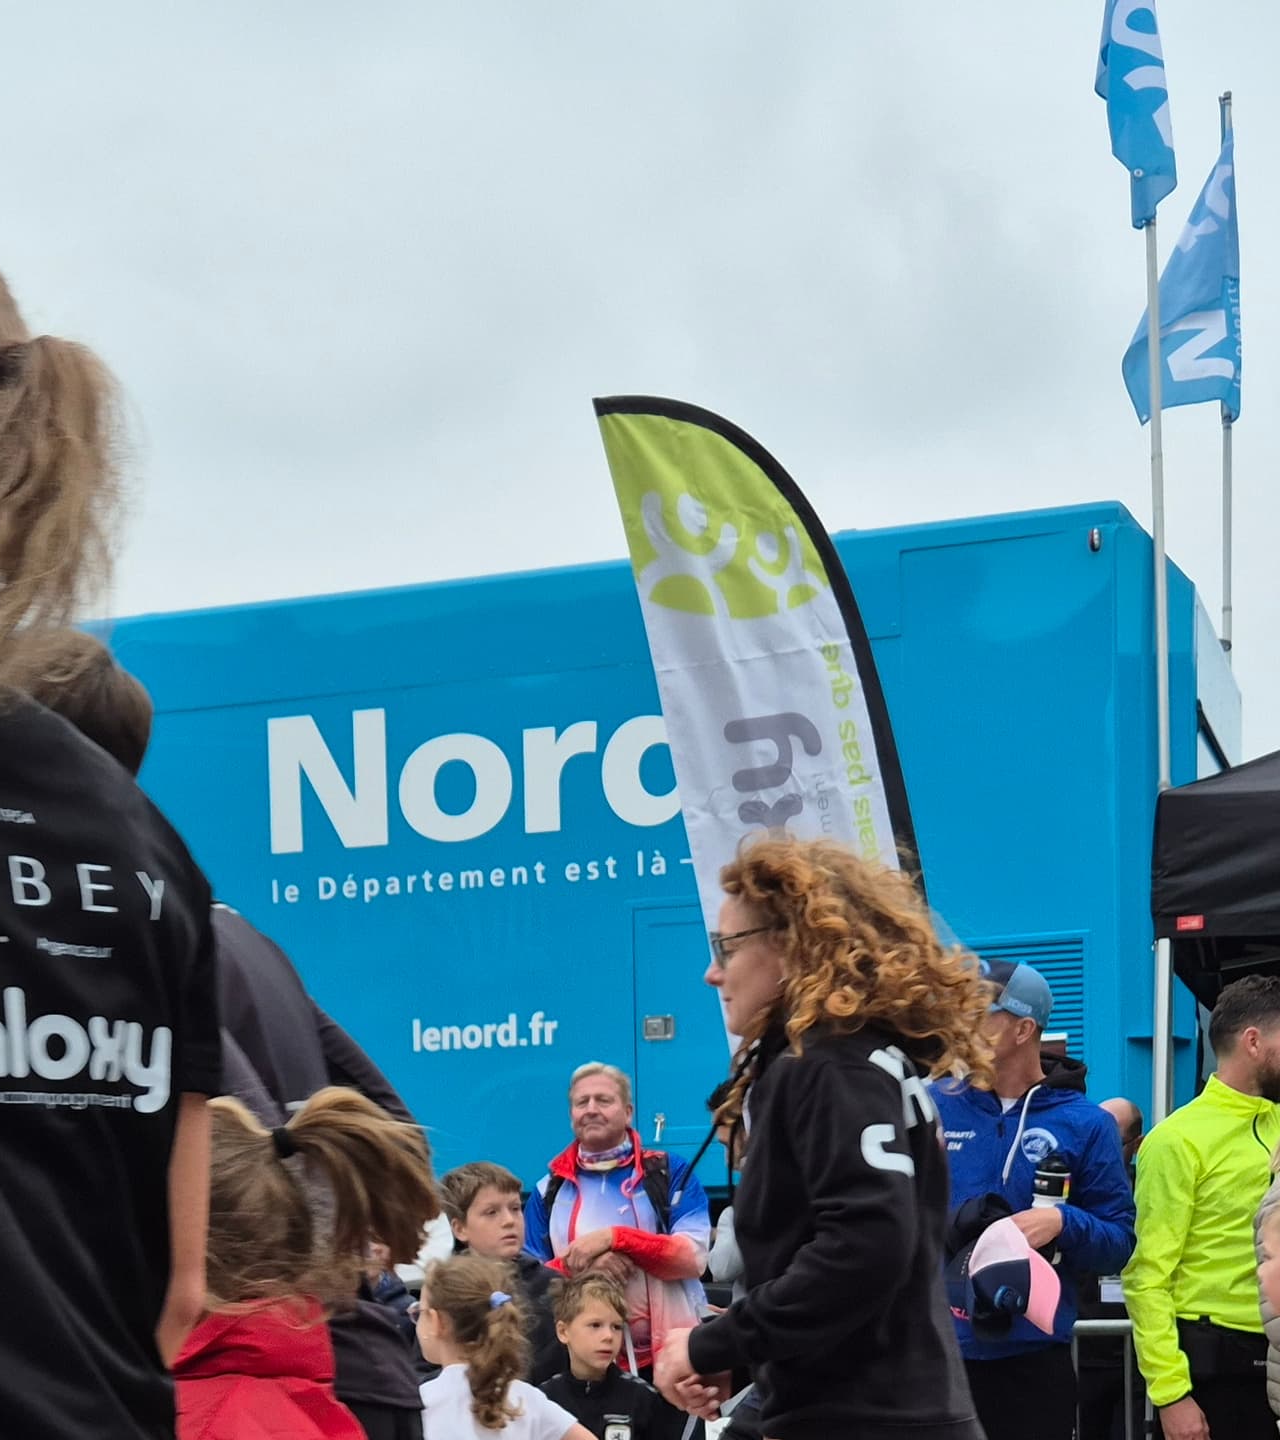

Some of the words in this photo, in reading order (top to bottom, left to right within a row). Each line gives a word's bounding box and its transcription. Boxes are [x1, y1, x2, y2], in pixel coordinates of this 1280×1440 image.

[272, 880, 299, 904] le
[318, 861, 546, 903] Département
[565, 855, 618, 882] est
[637, 850, 667, 877] là
[412, 1013, 558, 1052] lenord.fr
